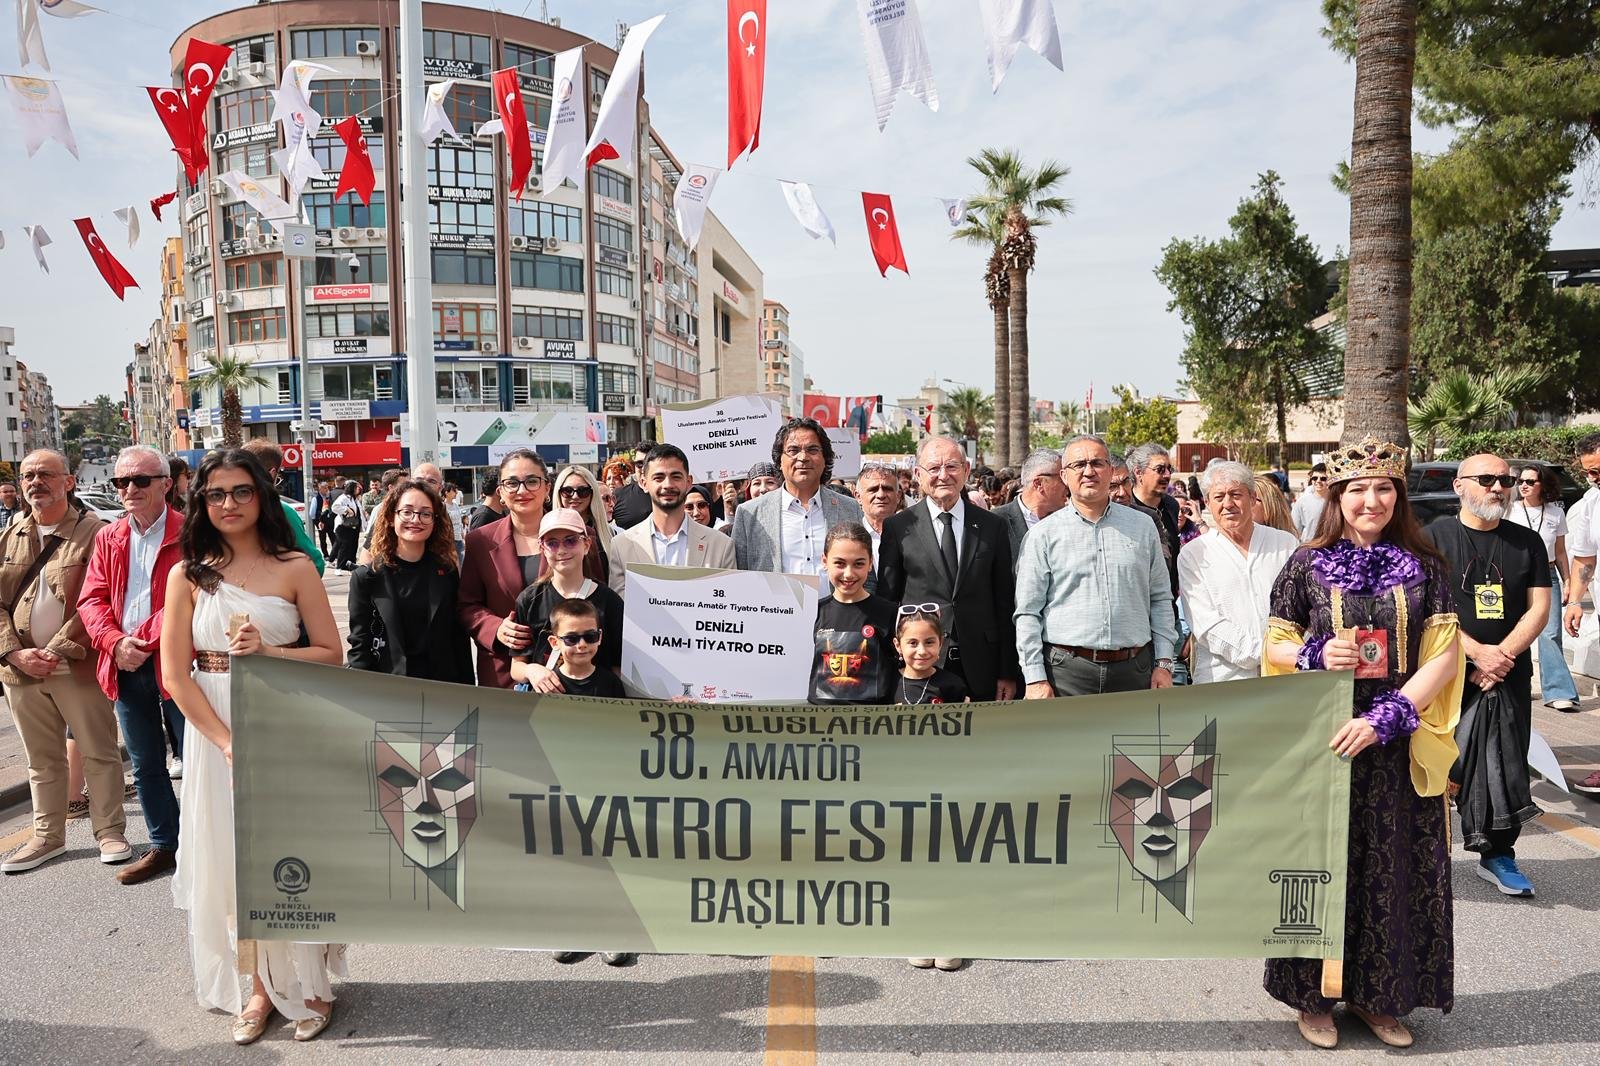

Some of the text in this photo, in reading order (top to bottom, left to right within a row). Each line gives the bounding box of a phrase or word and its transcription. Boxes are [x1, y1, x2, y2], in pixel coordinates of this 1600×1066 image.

[530, 80, 553, 90] AVUKA
[316, 288, 369, 296] AKSigorta
[546, 342, 573, 351] AVUKAT
[708, 428, 739, 438] DENİZLİ
[692, 438, 757, 451] KENDİNE SAHNE
[712, 589, 726, 598] 38.
[648, 598, 794, 614] Uluslararası Amatör Tiyatro Festivali
[696, 620, 744, 634] DENİZLİ
[652, 636, 786, 656] NAM-I TİYATRO DER.
[640, 710, 973, 780] 38. ULUSLARARASI
[722, 738, 862, 783] AMATÖR
[508, 786, 1072, 865] TİYATRO FESTİVALİ
[690, 878, 891, 929] BAŞLIYOR
[1263, 938, 1334, 948] ŞEHİR TİYATROSU
